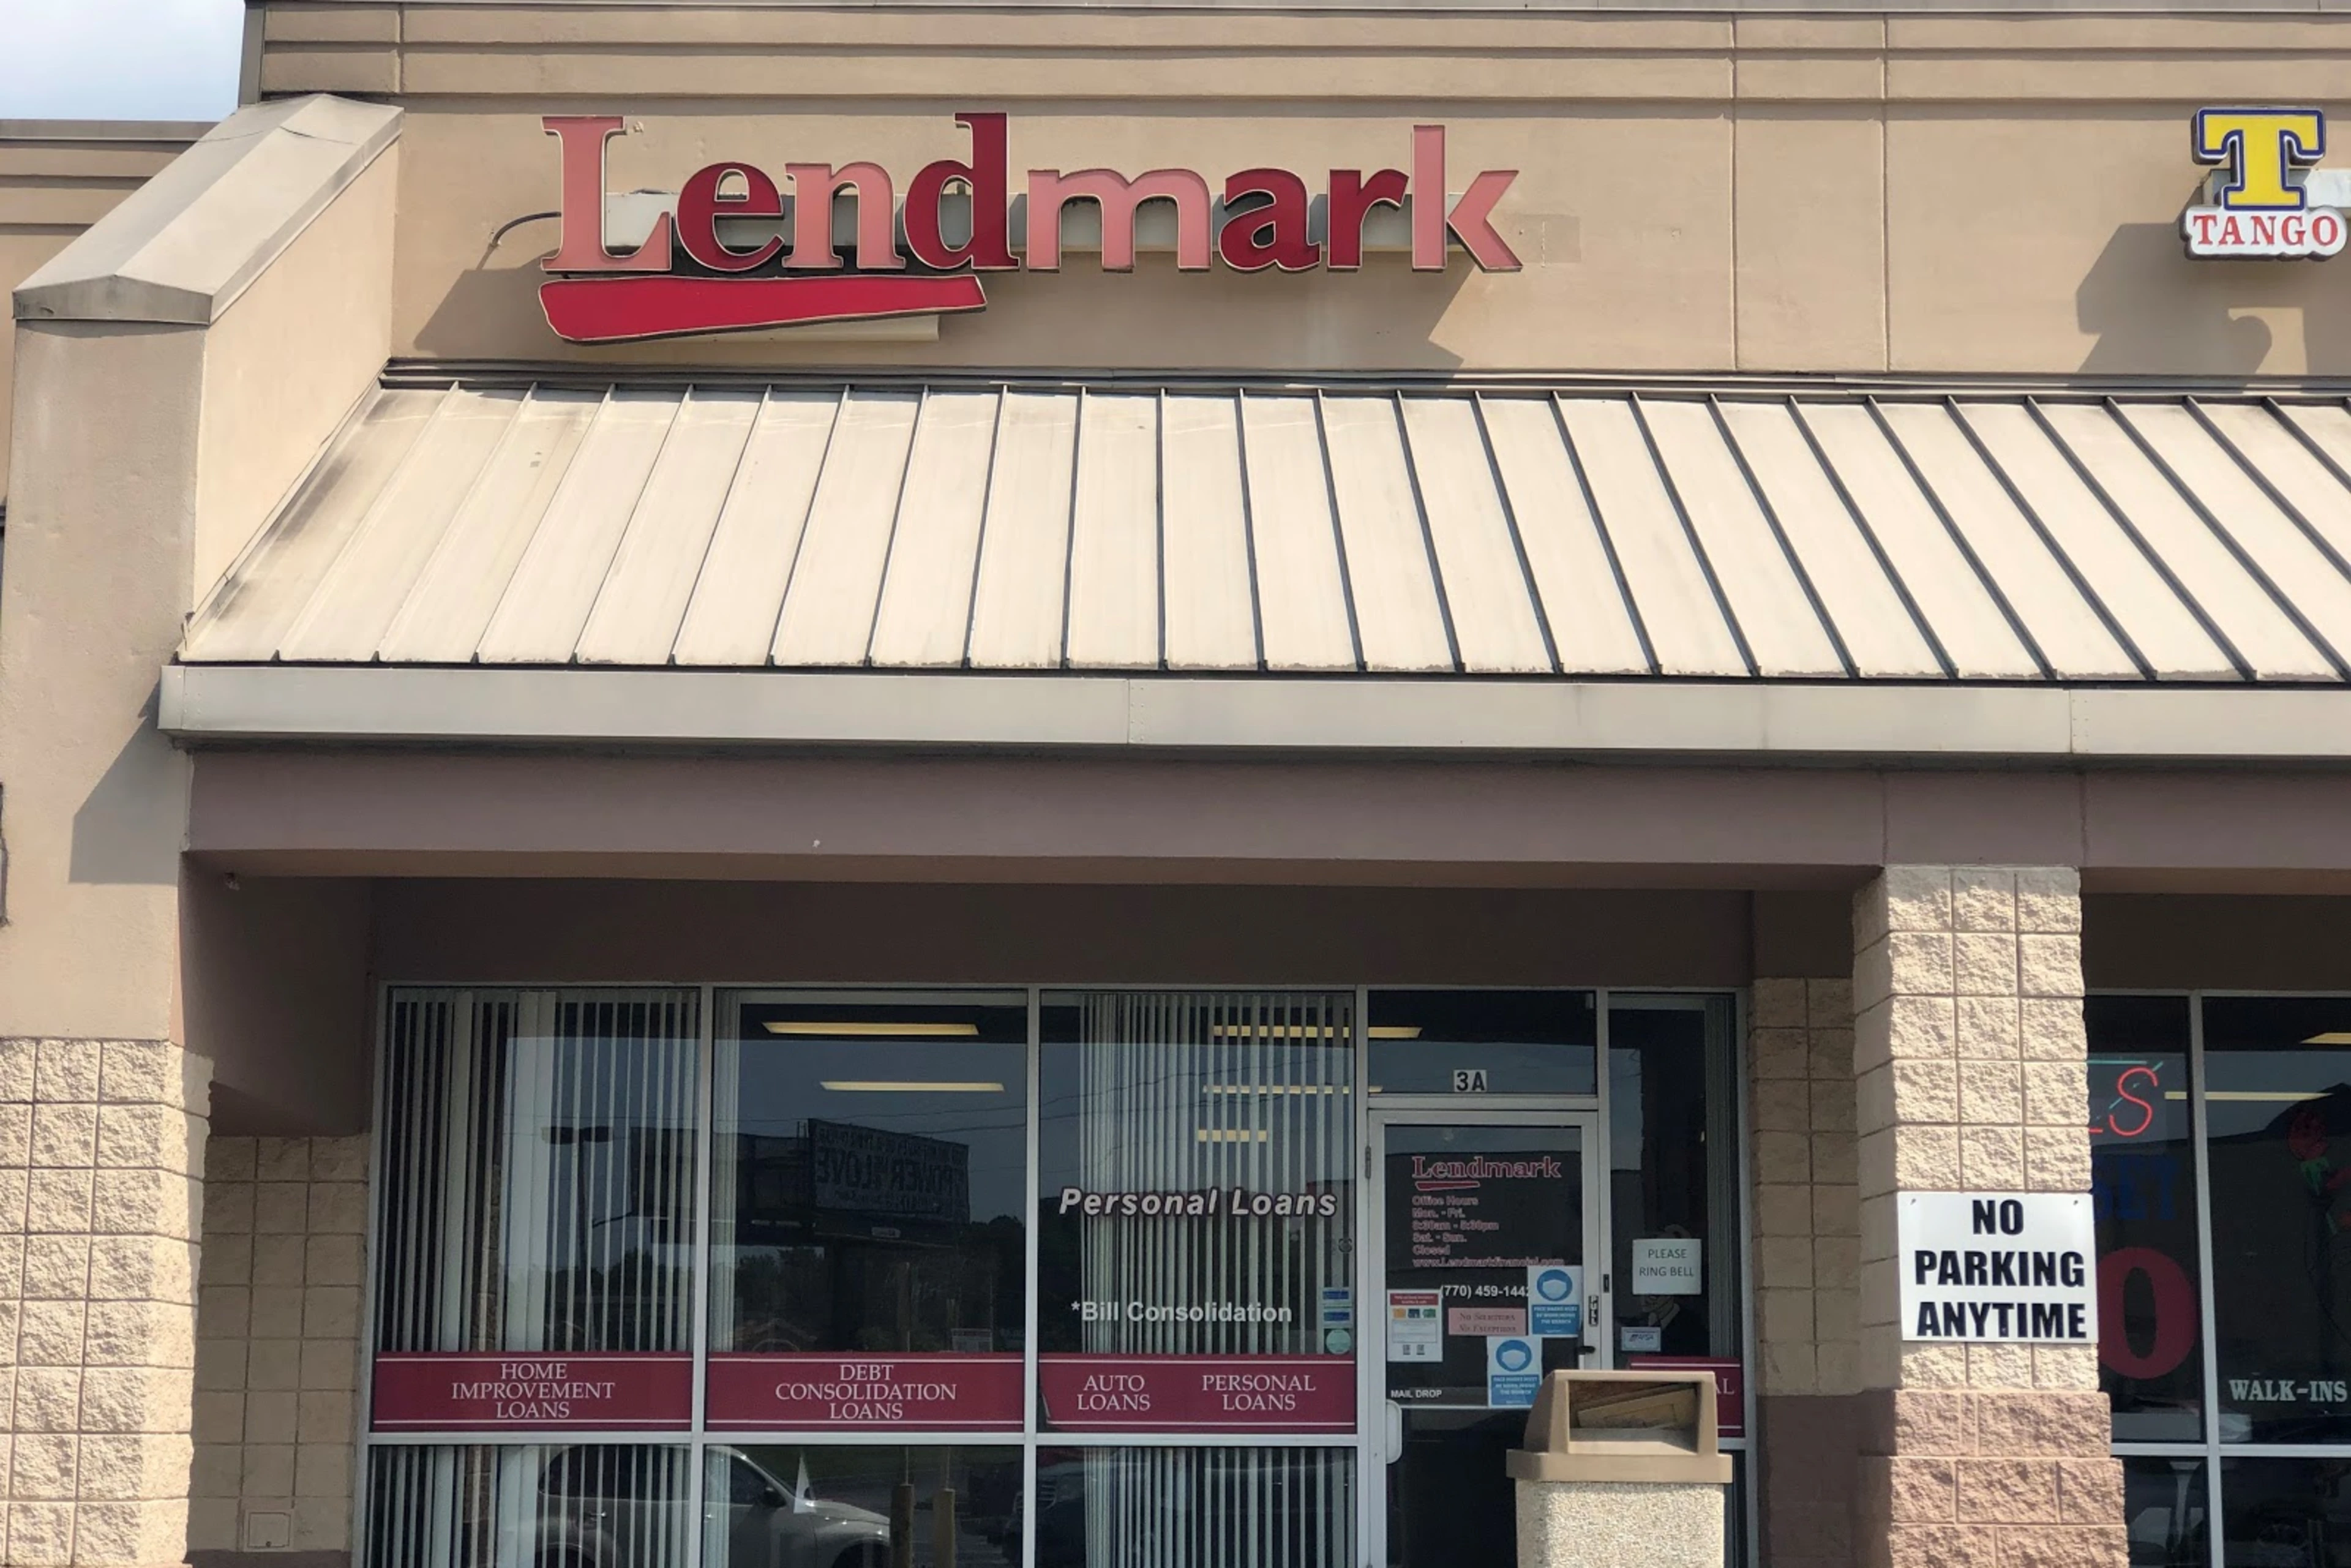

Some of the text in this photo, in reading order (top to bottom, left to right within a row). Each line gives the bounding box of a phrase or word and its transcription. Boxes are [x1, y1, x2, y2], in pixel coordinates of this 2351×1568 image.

[540, 110, 1524, 274] Lendmark
[2192, 214, 2339, 247] TANGO
[1456, 1071, 1485, 1092] 3A
[1411, 1155, 1562, 1179] Lendmark
[1058, 1187, 1338, 1217] Personal Loans
[1411, 1195, 1479, 1206] Office Hours
[1972, 1199, 2025, 1236] NO
[1412, 1244, 1451, 1255] Closed
[1648, 1248, 1687, 1259] PLEASE
[1639, 1267, 1694, 1277] RING BELL
[1914, 1250, 2085, 1288] PARKING
[1439, 1285, 1472, 1300] (770)
[1127, 1300, 1292, 1322] Consolidation
[1916, 1301, 2087, 1339] ANYTIME
[501, 1363, 568, 1380] HOME
[839, 1364, 894, 1381] DEBT
[451, 1382, 615, 1400] IMPROVEMENT
[1082, 1375, 1145, 1392] AUTO
[1201, 1375, 1316, 1392] PERSONAL
[2229, 1379, 2349, 1403] WALK-INS
[775, 1384, 957, 1401] CONSOLIDATION
[1390, 1389, 1442, 1398] MAIL DROP
[496, 1402, 570, 1419] LOANS
[1076, 1394, 1151, 1411] LOANS
[1222, 1394, 1296, 1411] LOANS
[830, 1403, 903, 1420] LOANS
